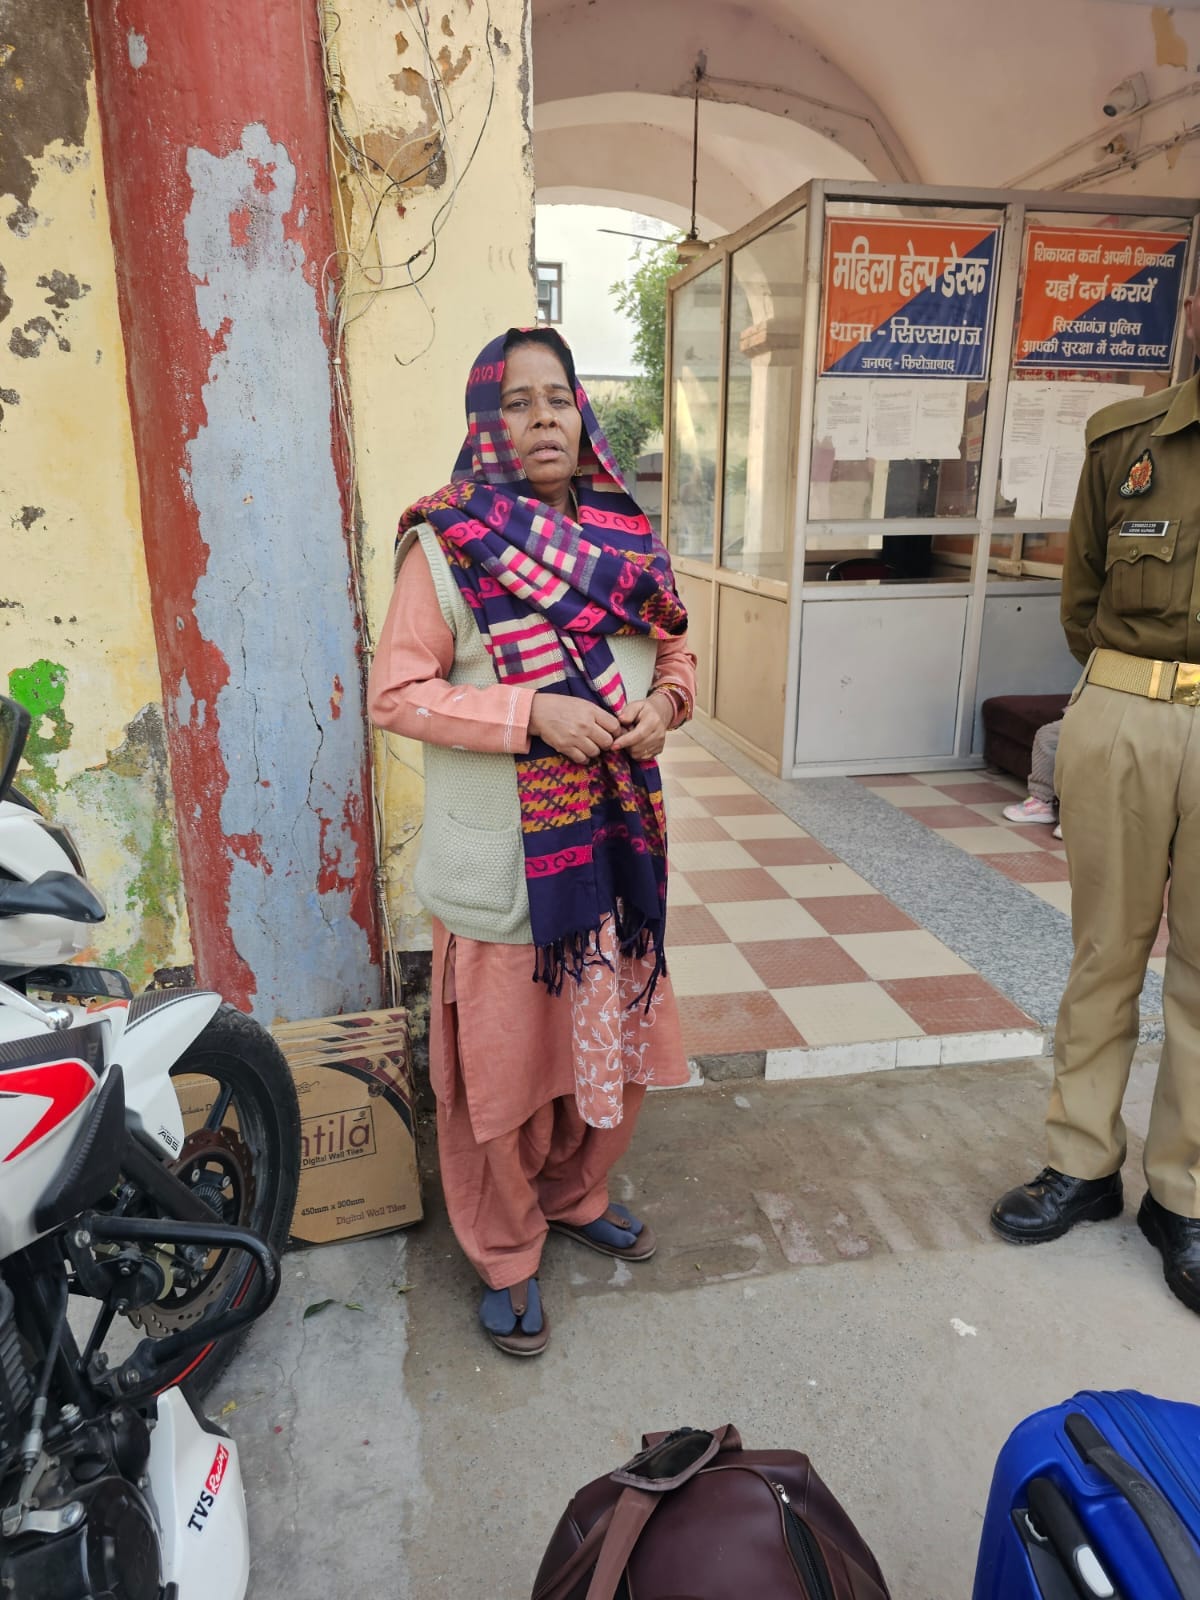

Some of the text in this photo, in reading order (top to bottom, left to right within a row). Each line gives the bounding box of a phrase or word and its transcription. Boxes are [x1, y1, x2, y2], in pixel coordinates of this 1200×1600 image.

[1034, 241, 1176, 268] शिकायत कर्ता अपनी शिकायत
[833, 235, 989, 298] महिला हेल्प डेस्क
[1045, 273, 1158, 303] यहाँ दर्ज करायें
[829, 321, 874, 343] थाना
[889, 316, 983, 346] सिरसागंज
[1109, 318, 1143, 338] पुलिस
[1021, 337, 1060, 353] आपकी
[1061, 340, 1094, 357] सुरक्षा
[1109, 341, 1135, 357] सदैव
[1137, 344, 1169, 358] तत्पर
[861, 356, 892, 371] जनपद
[901, 354, 955, 372] फिरोजाबाद
[157, 1130, 179, 1152] ABS
[302, 1147, 364, 1166] Digital Wall Tiles
[336, 1203, 406, 1225] Digital Wall Tiles
[187, 1490, 214, 1532] TVS
